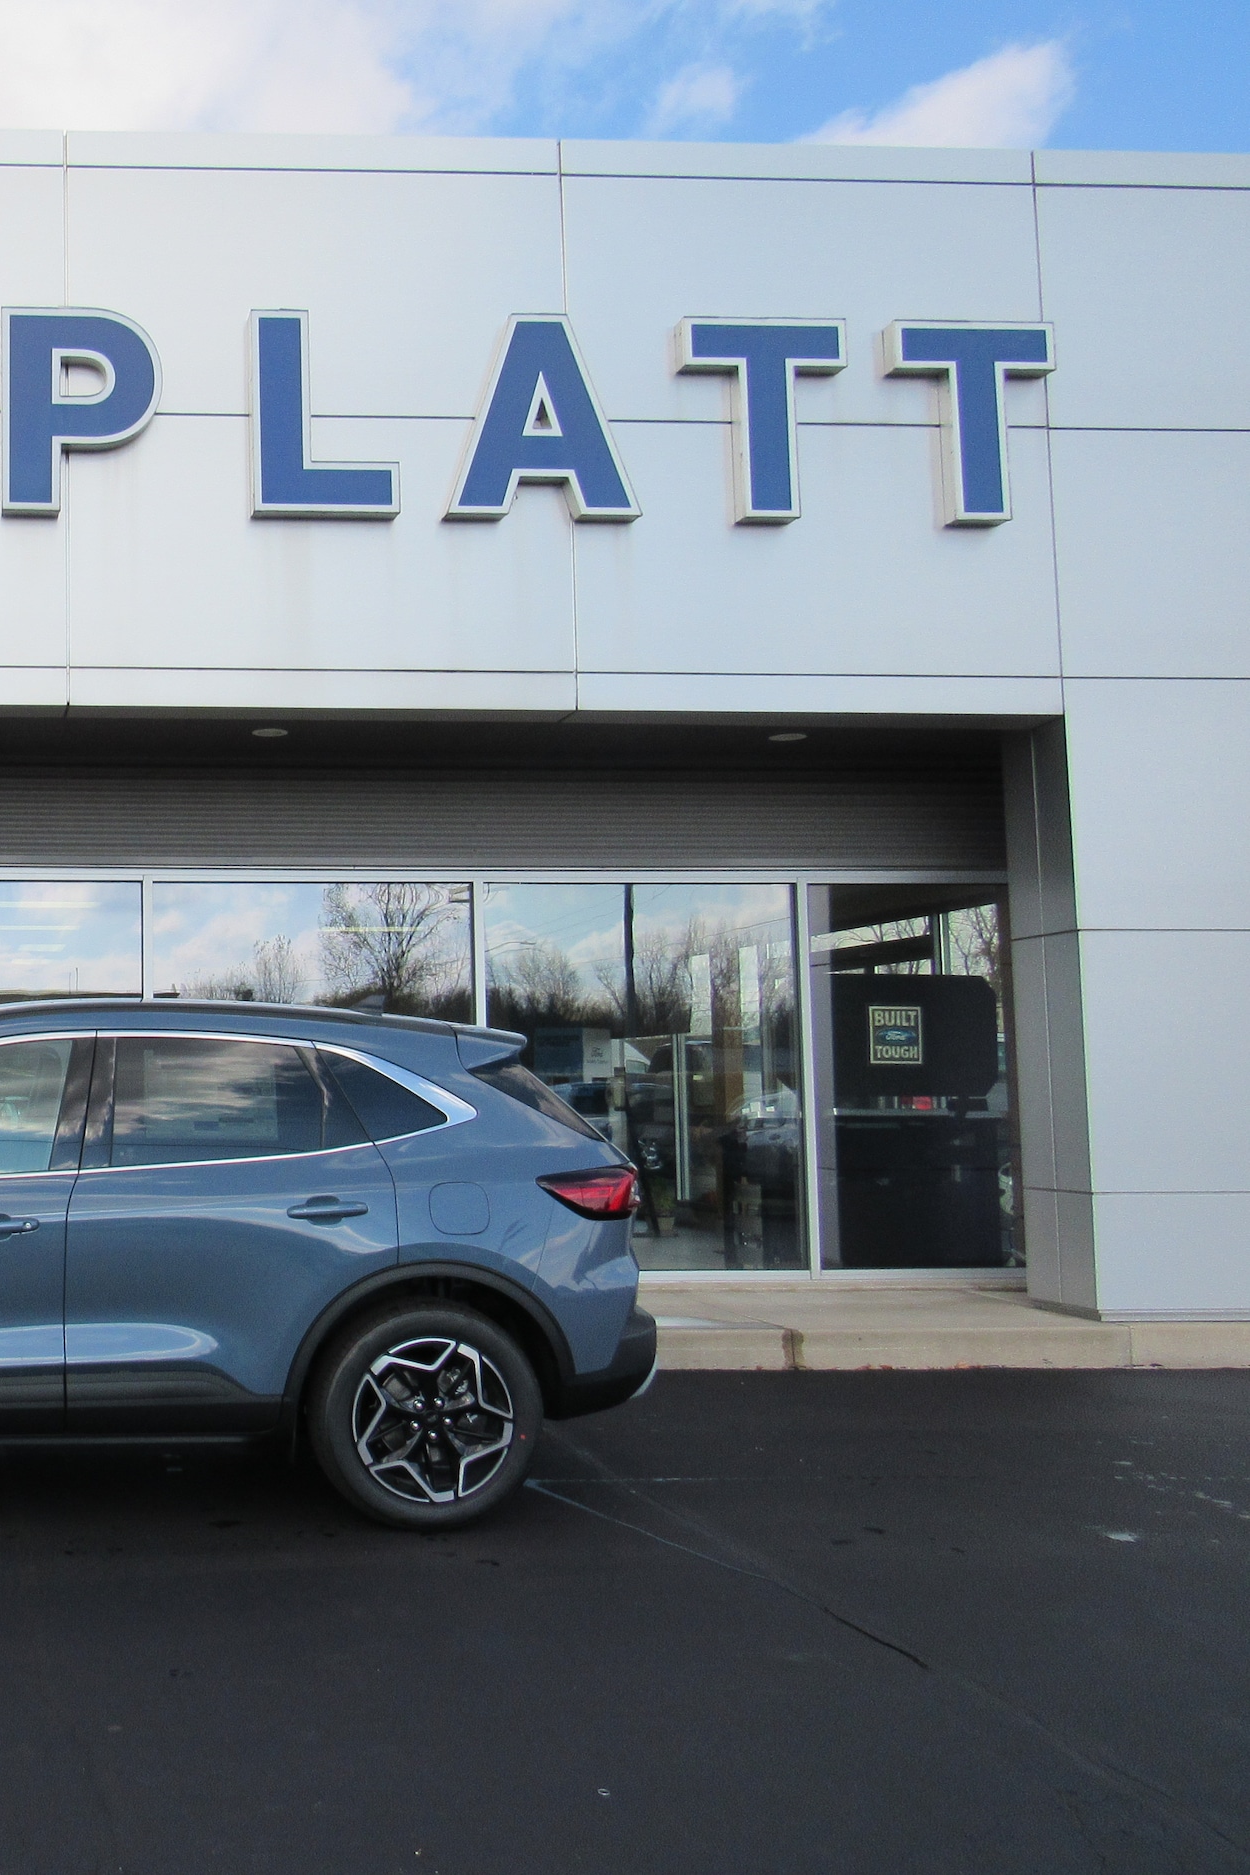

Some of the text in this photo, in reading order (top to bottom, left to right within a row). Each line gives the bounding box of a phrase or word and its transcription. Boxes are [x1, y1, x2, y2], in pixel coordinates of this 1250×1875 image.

[1, 306, 1056, 526] PLATT
[874, 1010, 917, 1026] BUILT
[874, 1045, 918, 1058] TOUGH
